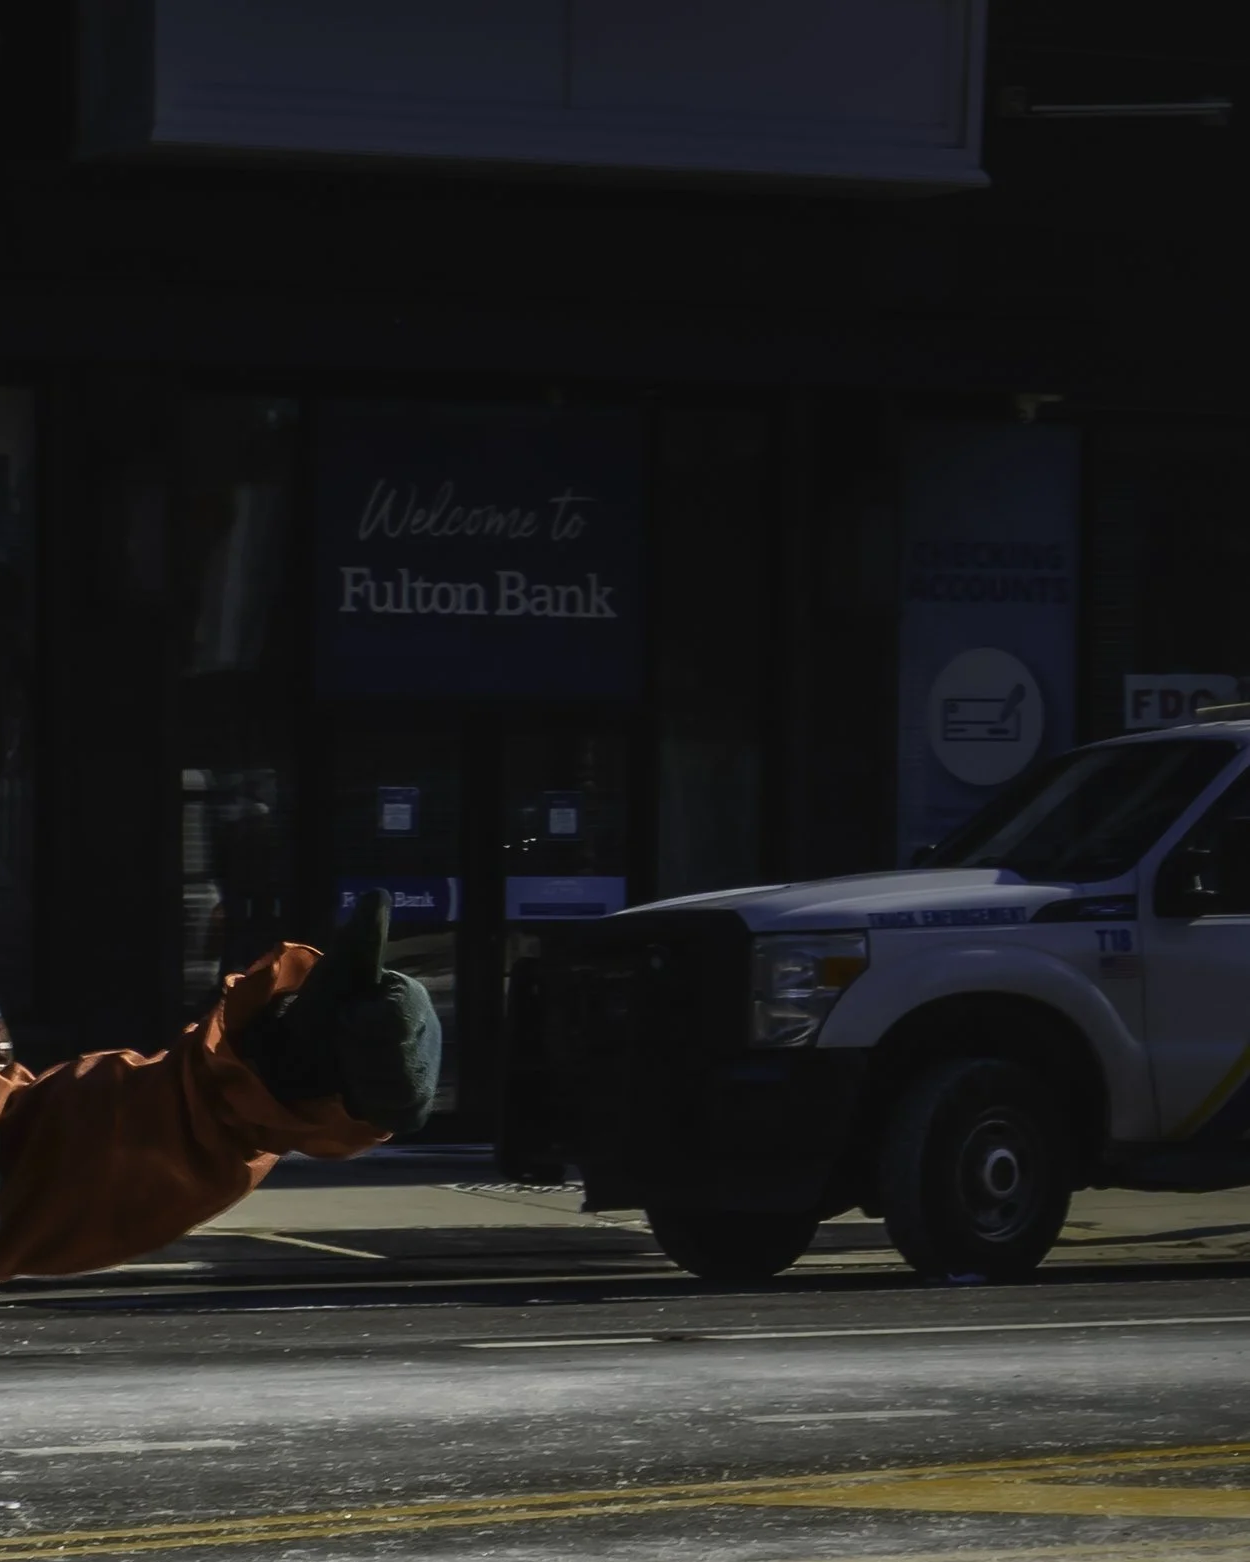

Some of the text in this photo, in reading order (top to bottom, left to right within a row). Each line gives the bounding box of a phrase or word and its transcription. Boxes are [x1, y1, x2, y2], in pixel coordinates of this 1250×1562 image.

[357, 477, 601, 543] Welcome to
[912, 541, 1064, 571] CHECKING
[338, 566, 619, 619] Fulton Bank
[908, 573, 1071, 606] ACCOUNTS
[393, 890, 436, 908] Bank
